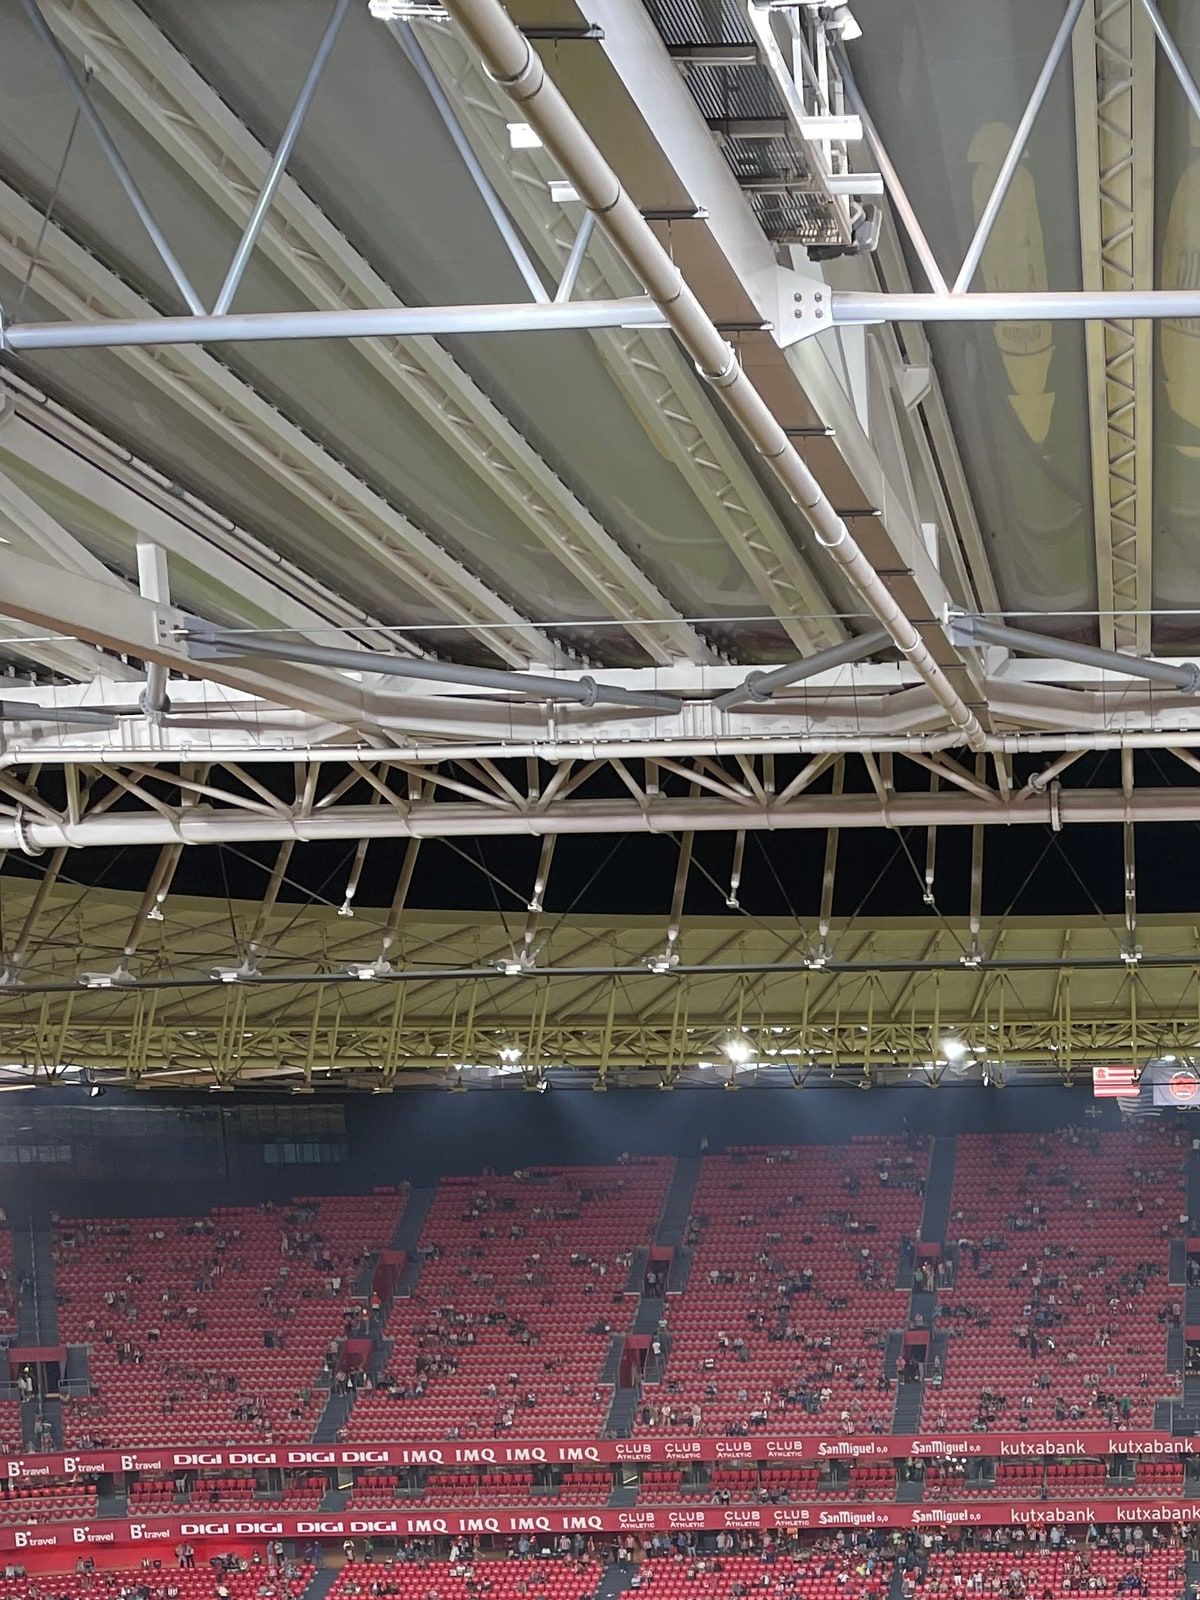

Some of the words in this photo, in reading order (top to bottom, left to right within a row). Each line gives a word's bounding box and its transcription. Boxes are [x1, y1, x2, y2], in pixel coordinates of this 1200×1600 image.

[615, 1443, 651, 1453] CLUB
[664, 1443, 701, 1452] CLUB
[715, 1442, 752, 1451] CLUB
[766, 1441, 803, 1450] CLUB
[1001, 1440, 1085, 1454] kutxabank
[1109, 1439, 1193, 1453] kutxabank
[174, 1454, 222, 1464] DIGI
[229, 1454, 276, 1463] DIGI
[288, 1452, 335, 1462] DIGI
[342, 1452, 388, 1462] DIGI
[403, 1450, 444, 1464] IMQ
[456, 1449, 497, 1462] IMQ
[506, 1448, 547, 1462] IMQ
[559, 1447, 600, 1461] IMQ
[78, 1462, 104, 1472] travel
[135, 1459, 161, 1470] travel
[22, 1465, 49, 1476] travel
[618, 1513, 655, 1522] CLUB
[668, 1512, 704, 1521] CLUB
[724, 1511, 760, 1520] CLUB
[773, 1510, 809, 1519] CLUB
[1011, 1506, 1096, 1522] kutxabank
[1117, 1505, 1200, 1521] kutxabank
[236, 1523, 282, 1533] DIGI
[297, 1522, 343, 1532] DIGI
[351, 1522, 396, 1531] DIGI
[408, 1519, 448, 1533] IMQ
[460, 1518, 500, 1532] IMQ
[511, 1517, 551, 1531] IMQ
[563, 1516, 603, 1530] IMQ
[620, 1521, 655, 1529] ATHLETIC
[670, 1520, 704, 1528] ATHLETIC
[726, 1519, 760, 1527] ATHLETIC
[775, 1519, 809, 1527] ATHLETIC
[143, 1528, 170, 1539] travel
[181, 1524, 229, 1534] DIGI
[30, 1535, 56, 1546] travel
[87, 1531, 114, 1542] travel
